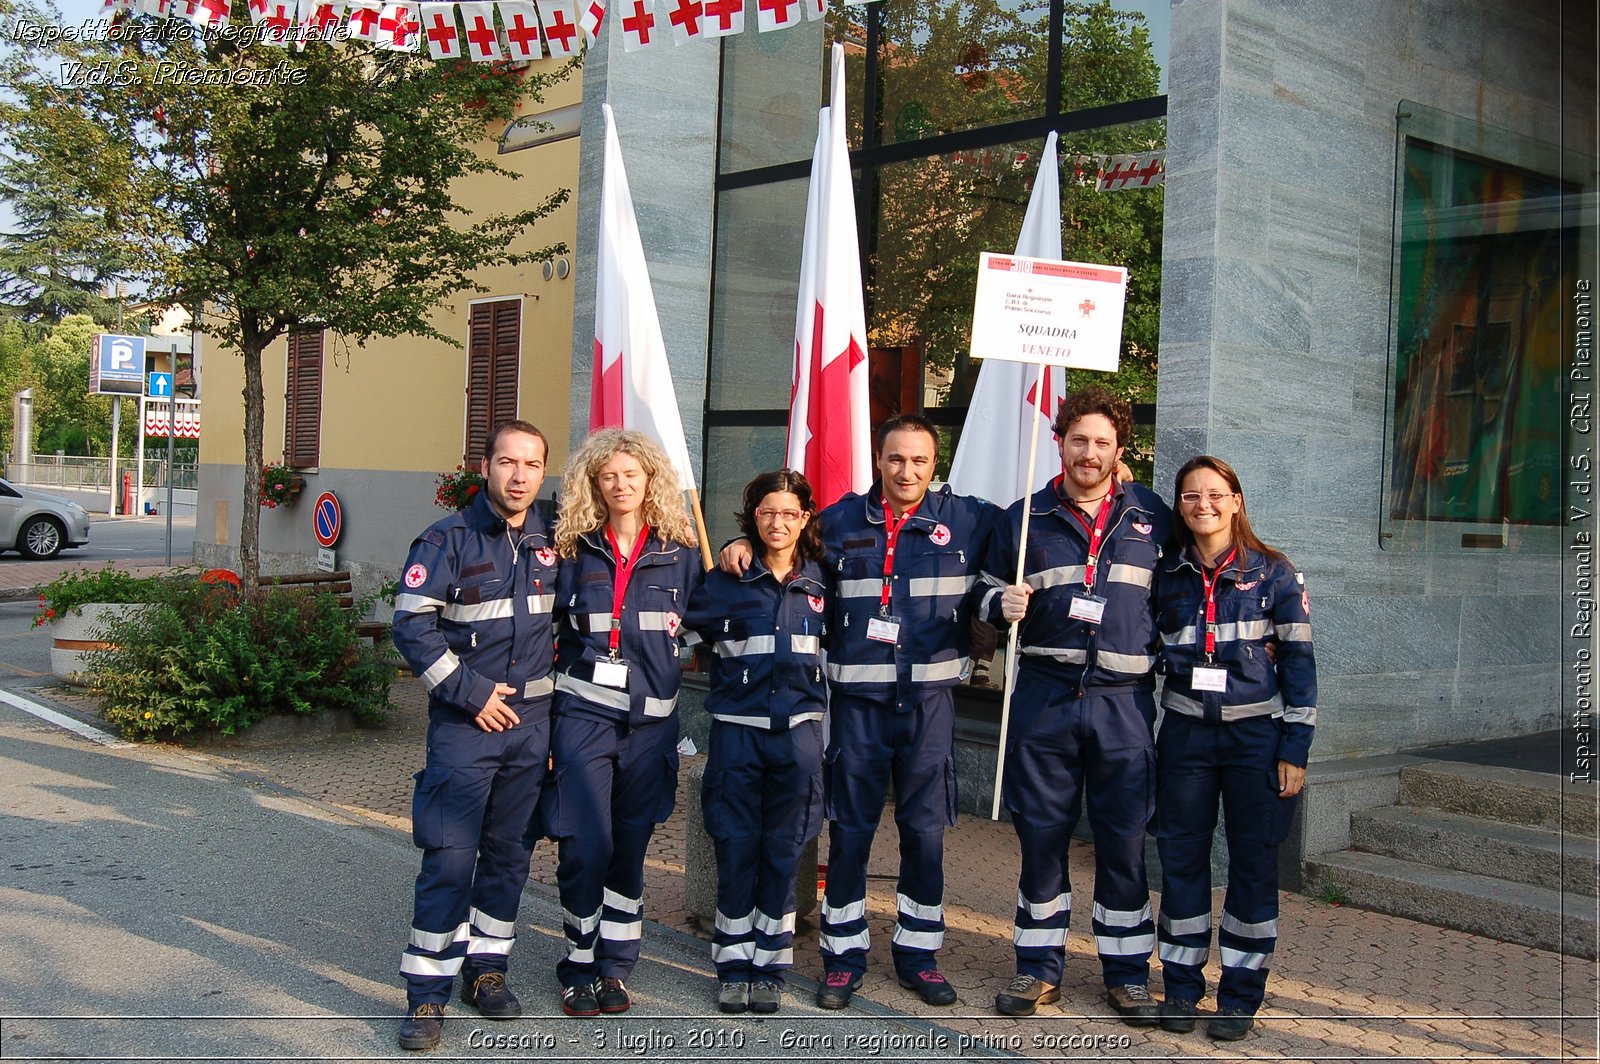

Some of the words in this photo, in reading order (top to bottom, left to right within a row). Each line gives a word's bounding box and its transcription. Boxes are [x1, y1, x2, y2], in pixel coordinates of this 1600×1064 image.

[1018, 323, 1077, 339] SQUADRA
[111, 345, 133, 370] P
[1022, 343, 1071, 358] VENETO
